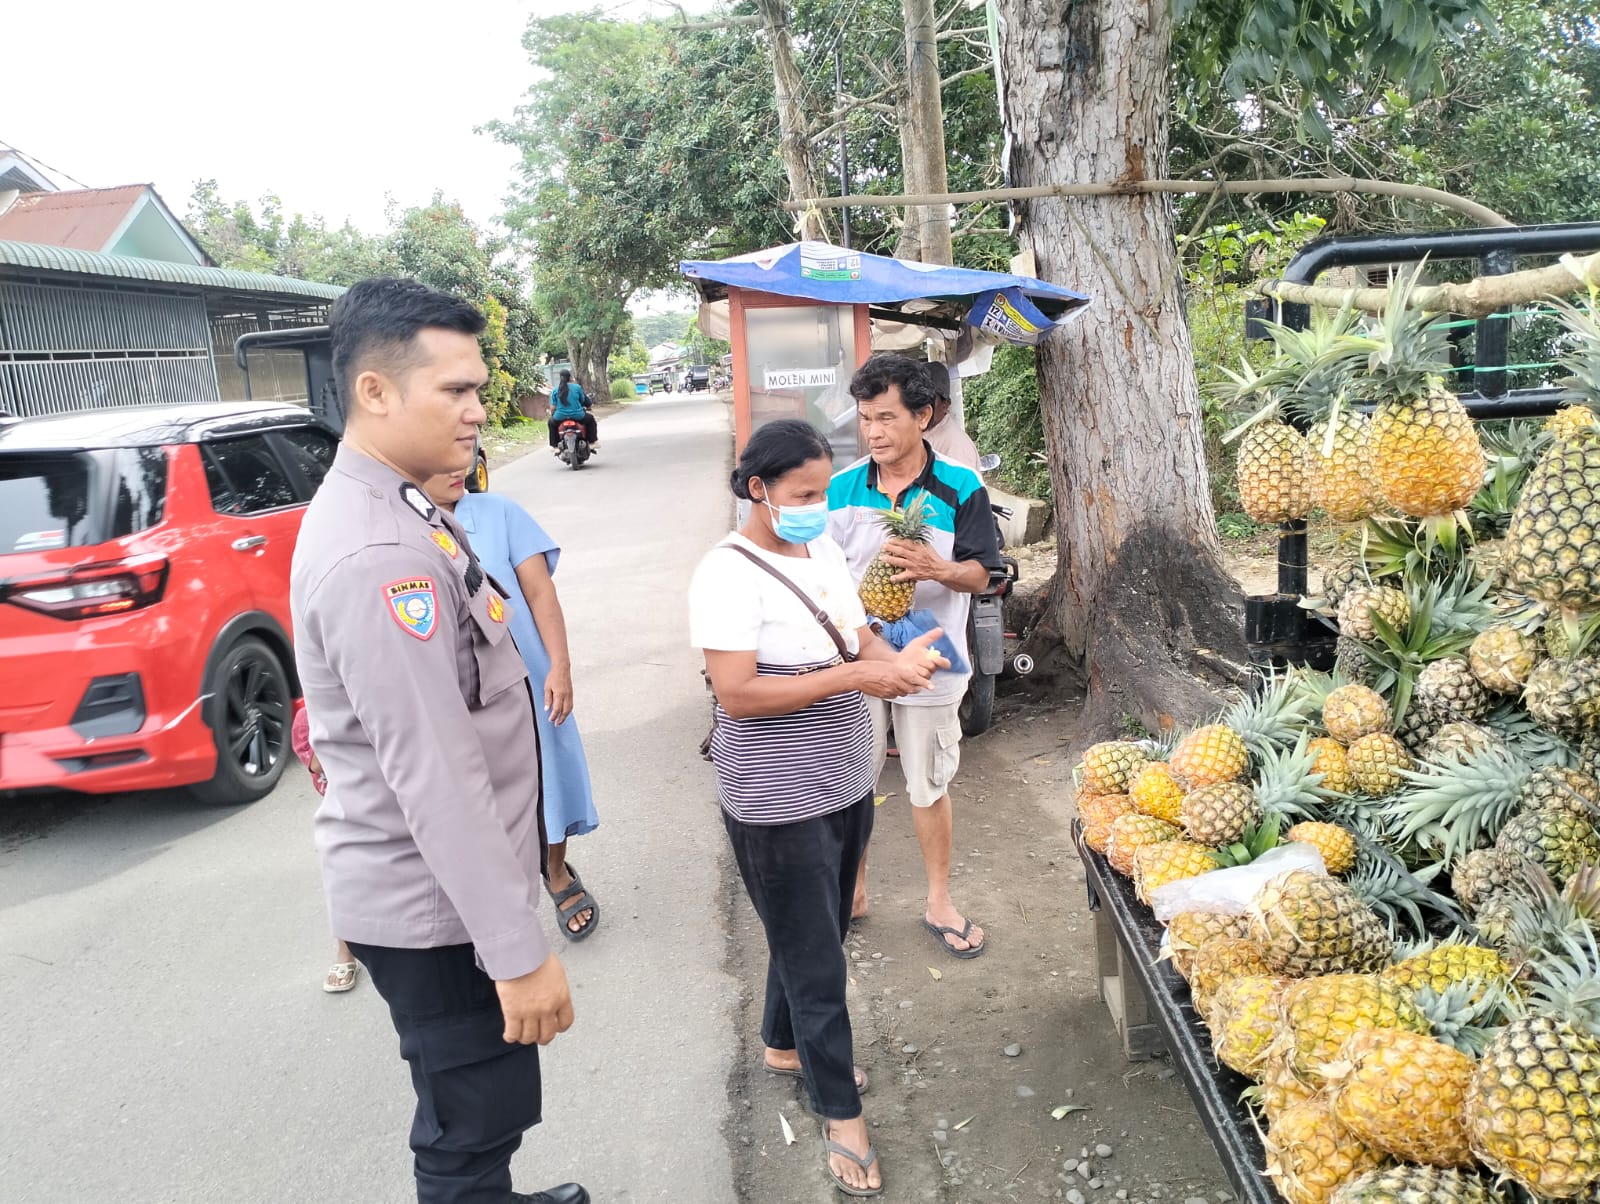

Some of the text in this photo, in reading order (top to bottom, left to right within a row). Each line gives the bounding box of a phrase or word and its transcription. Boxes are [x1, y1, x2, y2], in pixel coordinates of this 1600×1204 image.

[990, 305, 1001, 317] 12
[810, 372, 834, 384] MINI
[390, 582, 429, 594] BINMAS
